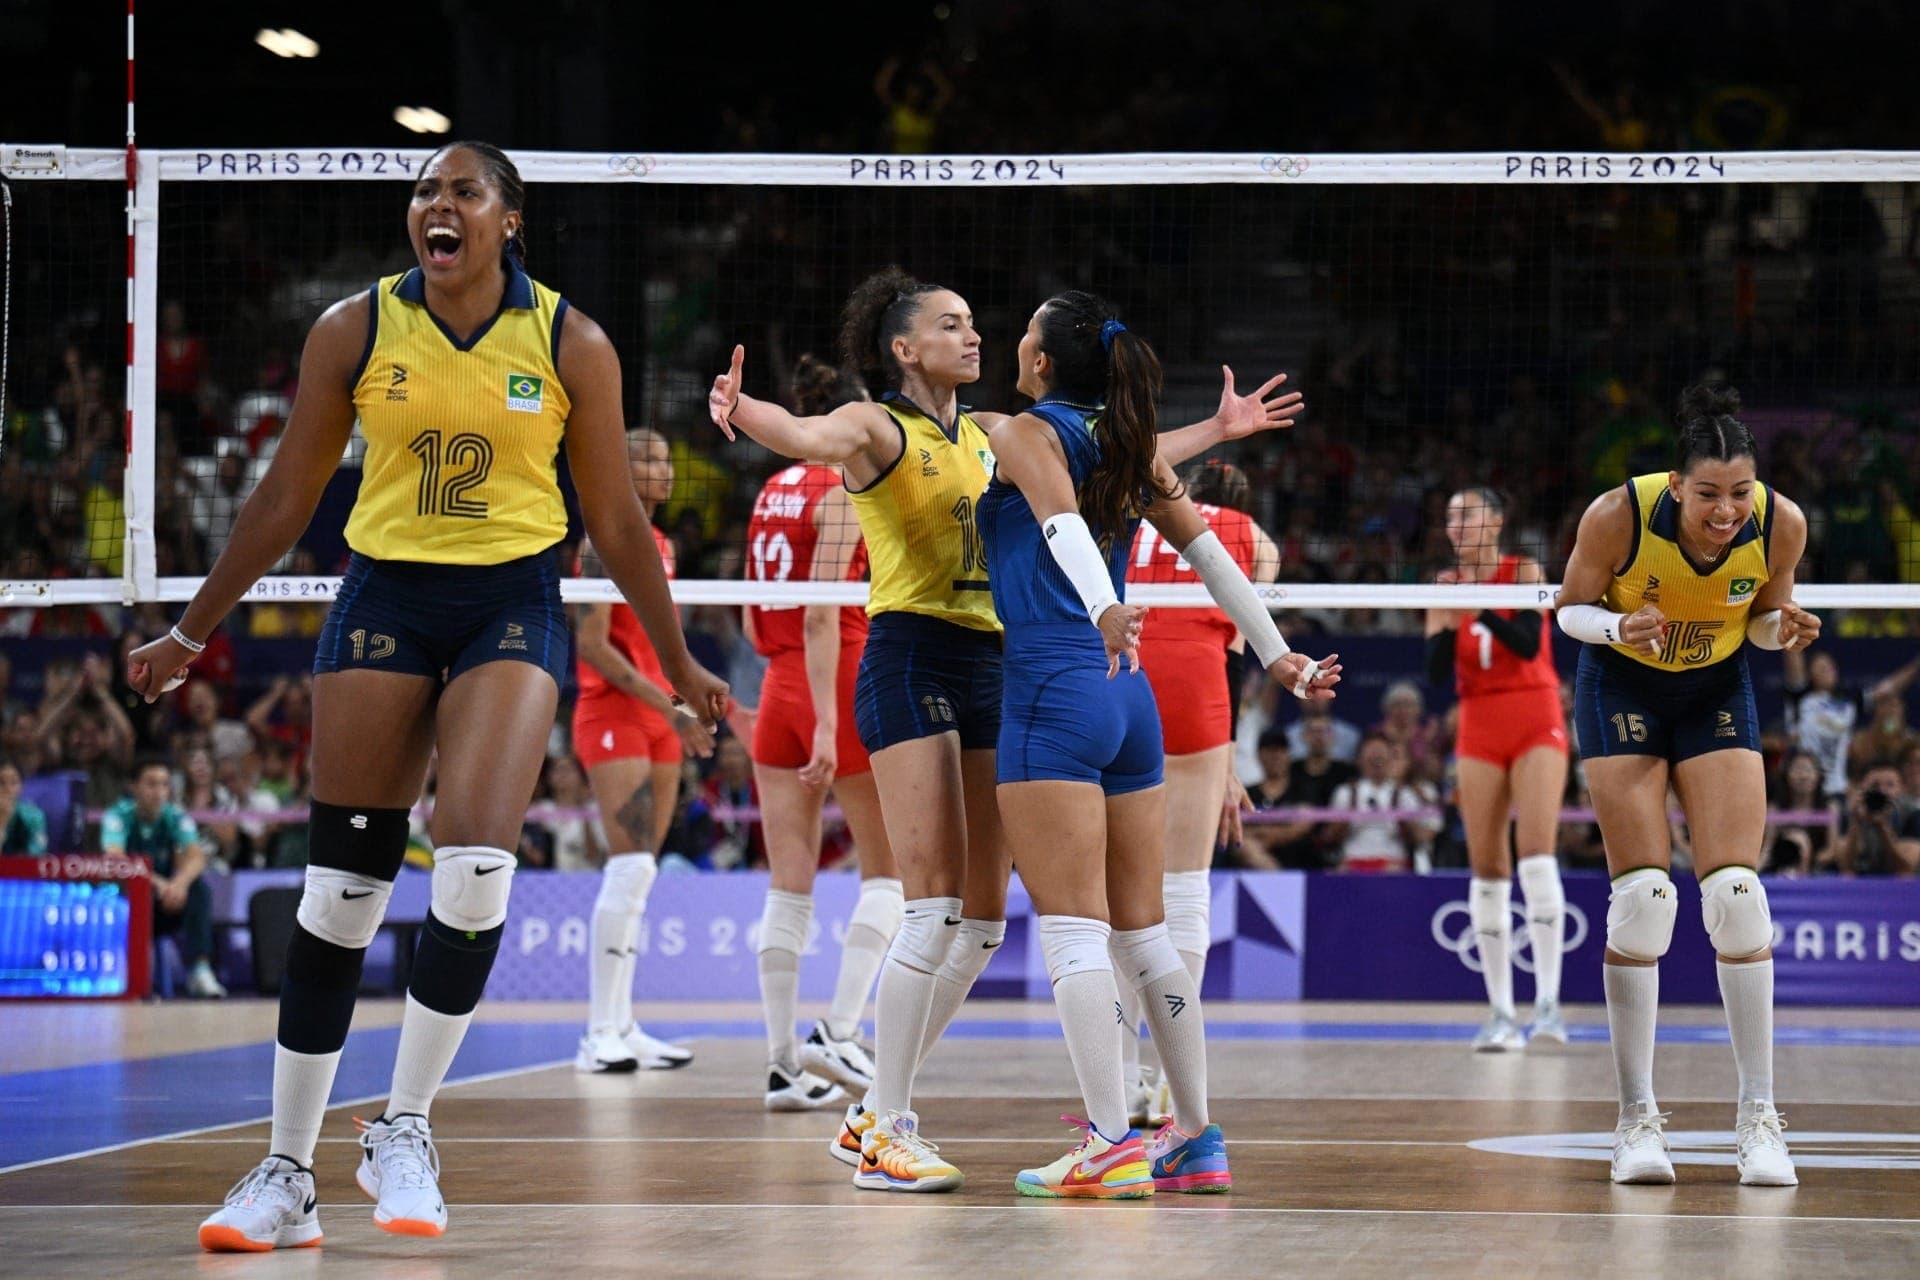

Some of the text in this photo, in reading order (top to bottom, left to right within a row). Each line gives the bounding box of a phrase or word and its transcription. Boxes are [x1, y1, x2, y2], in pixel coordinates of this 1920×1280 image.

[318, 152, 411, 174] 2024
[971, 159, 1064, 180] 2024
[1629, 156, 1724, 178] 2024
[508, 400, 541, 411] BRASIL
[408, 430, 494, 519] 12
[349, 628, 396, 661] 12
[1658, 620, 1726, 666] 15
[1610, 712, 1648, 744] 15
[601, 729, 615, 751] 4
[63, 854, 149, 879] OMEGA
